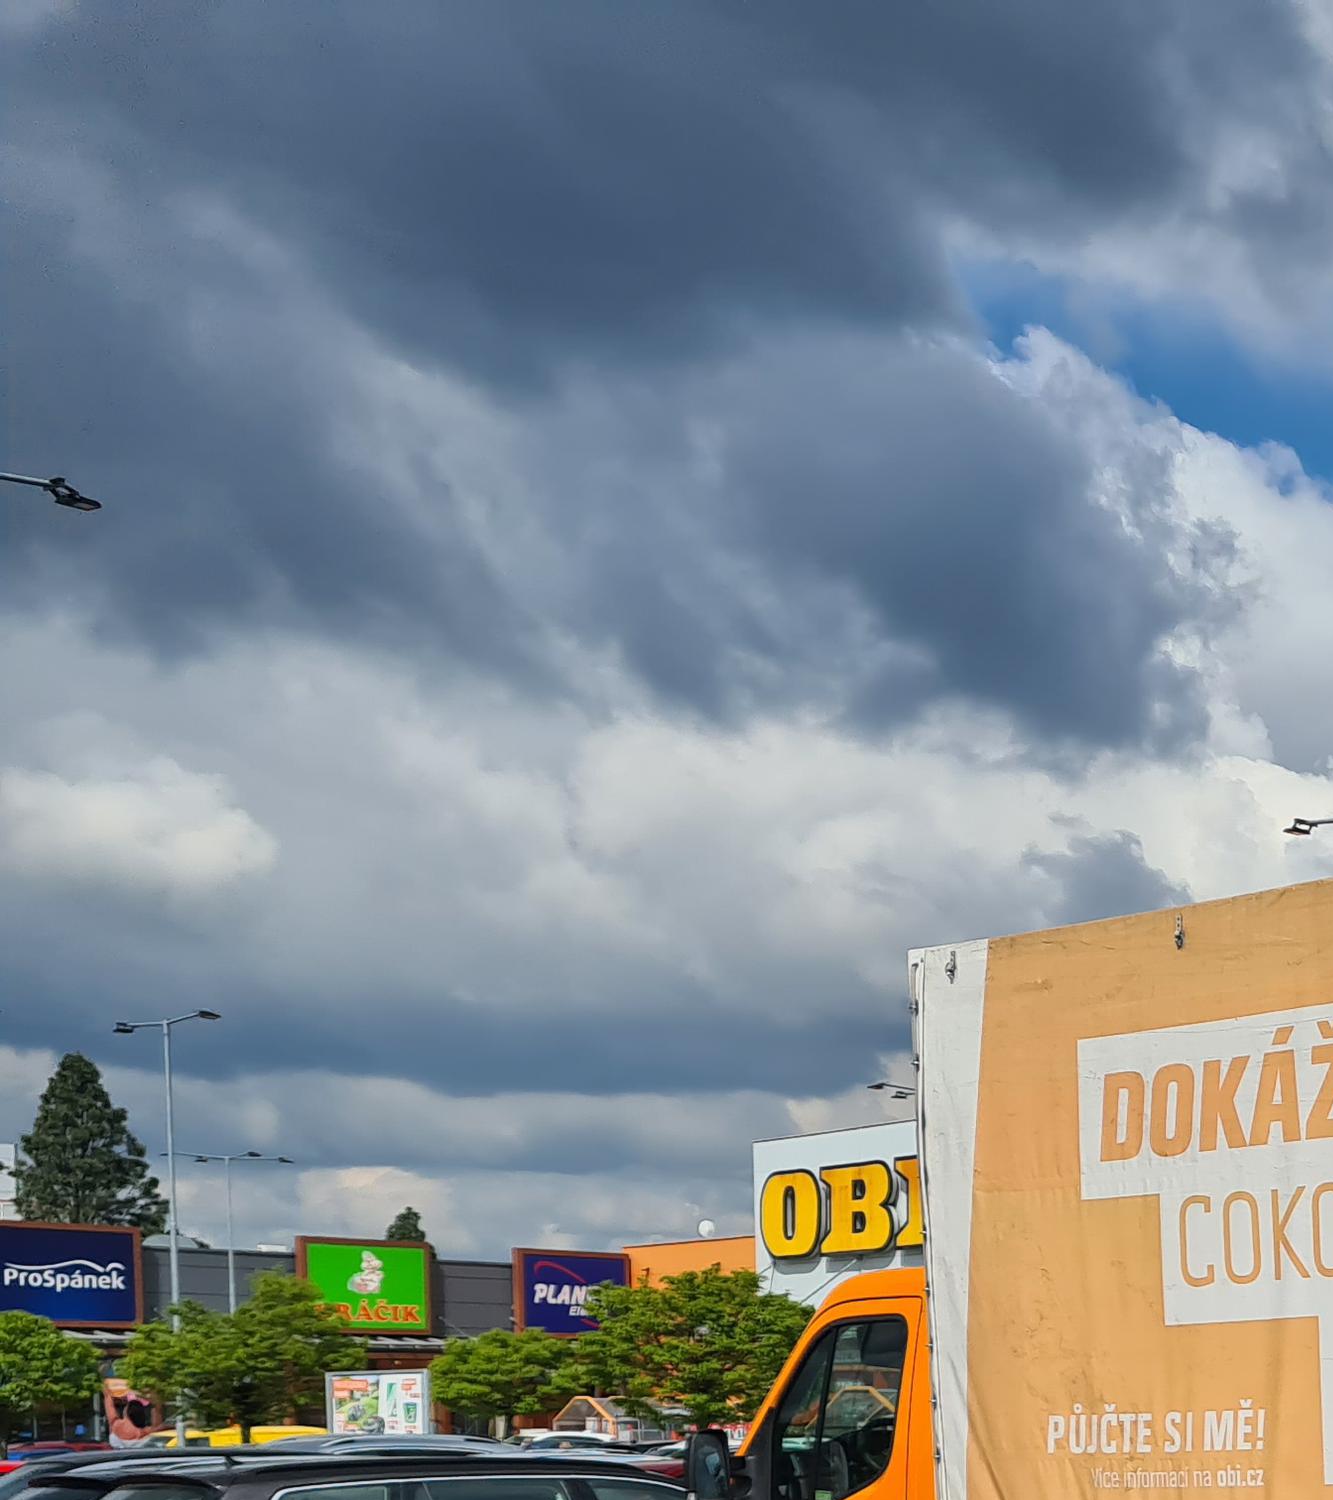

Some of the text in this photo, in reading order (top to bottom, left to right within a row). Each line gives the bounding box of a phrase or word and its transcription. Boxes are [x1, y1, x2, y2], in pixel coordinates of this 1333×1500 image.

[3, 1268, 126, 1292] ProSpánek
[313, 1299, 420, 1323] RÁČIK
[1047, 1398, 1266, 1454] PŮJČTE SI MĚ!
[1193, 1471, 1212, 1487] na
[1216, 1464, 1265, 1487] obi.cz
